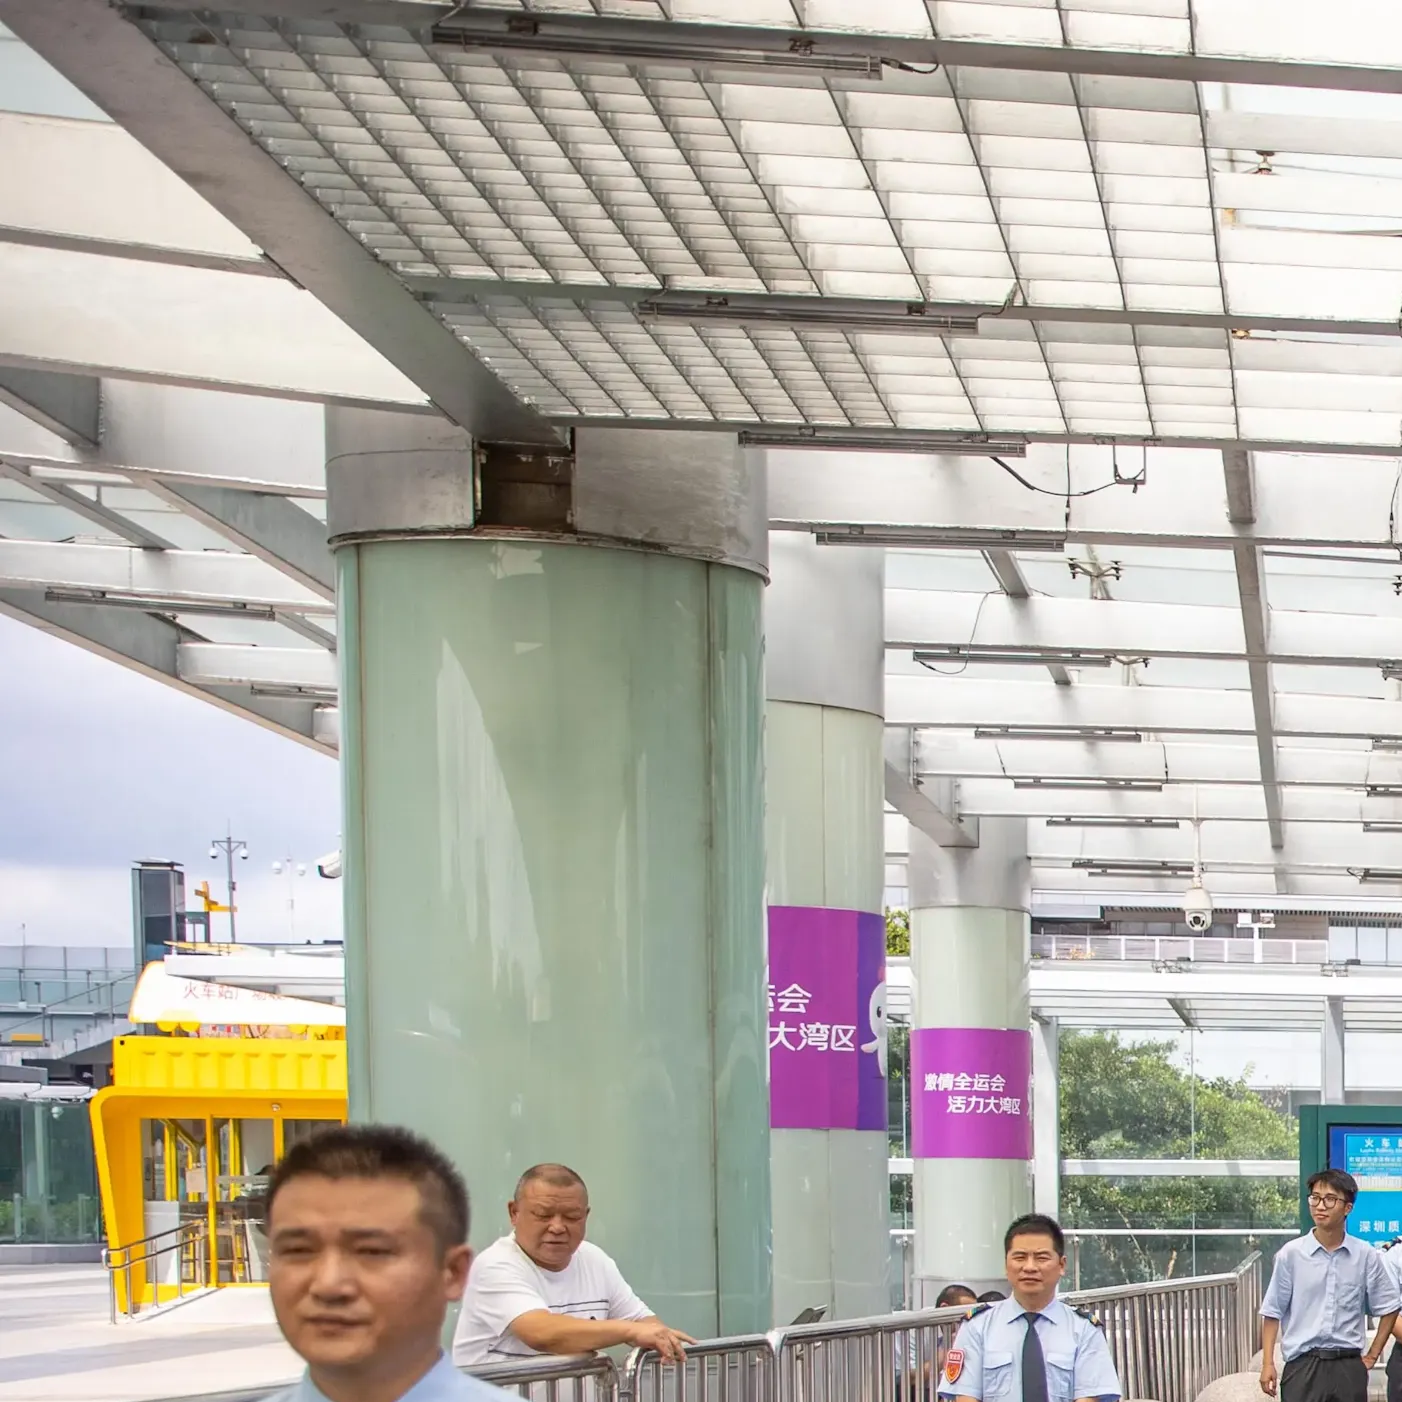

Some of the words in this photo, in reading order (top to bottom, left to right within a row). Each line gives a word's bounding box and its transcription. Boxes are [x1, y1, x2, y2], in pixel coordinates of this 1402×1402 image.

[768, 1020, 857, 1052] 大湾区
[924, 1072, 1006, 1092] 激情全运会
[946, 1095, 1021, 1115] 活力大湾区
